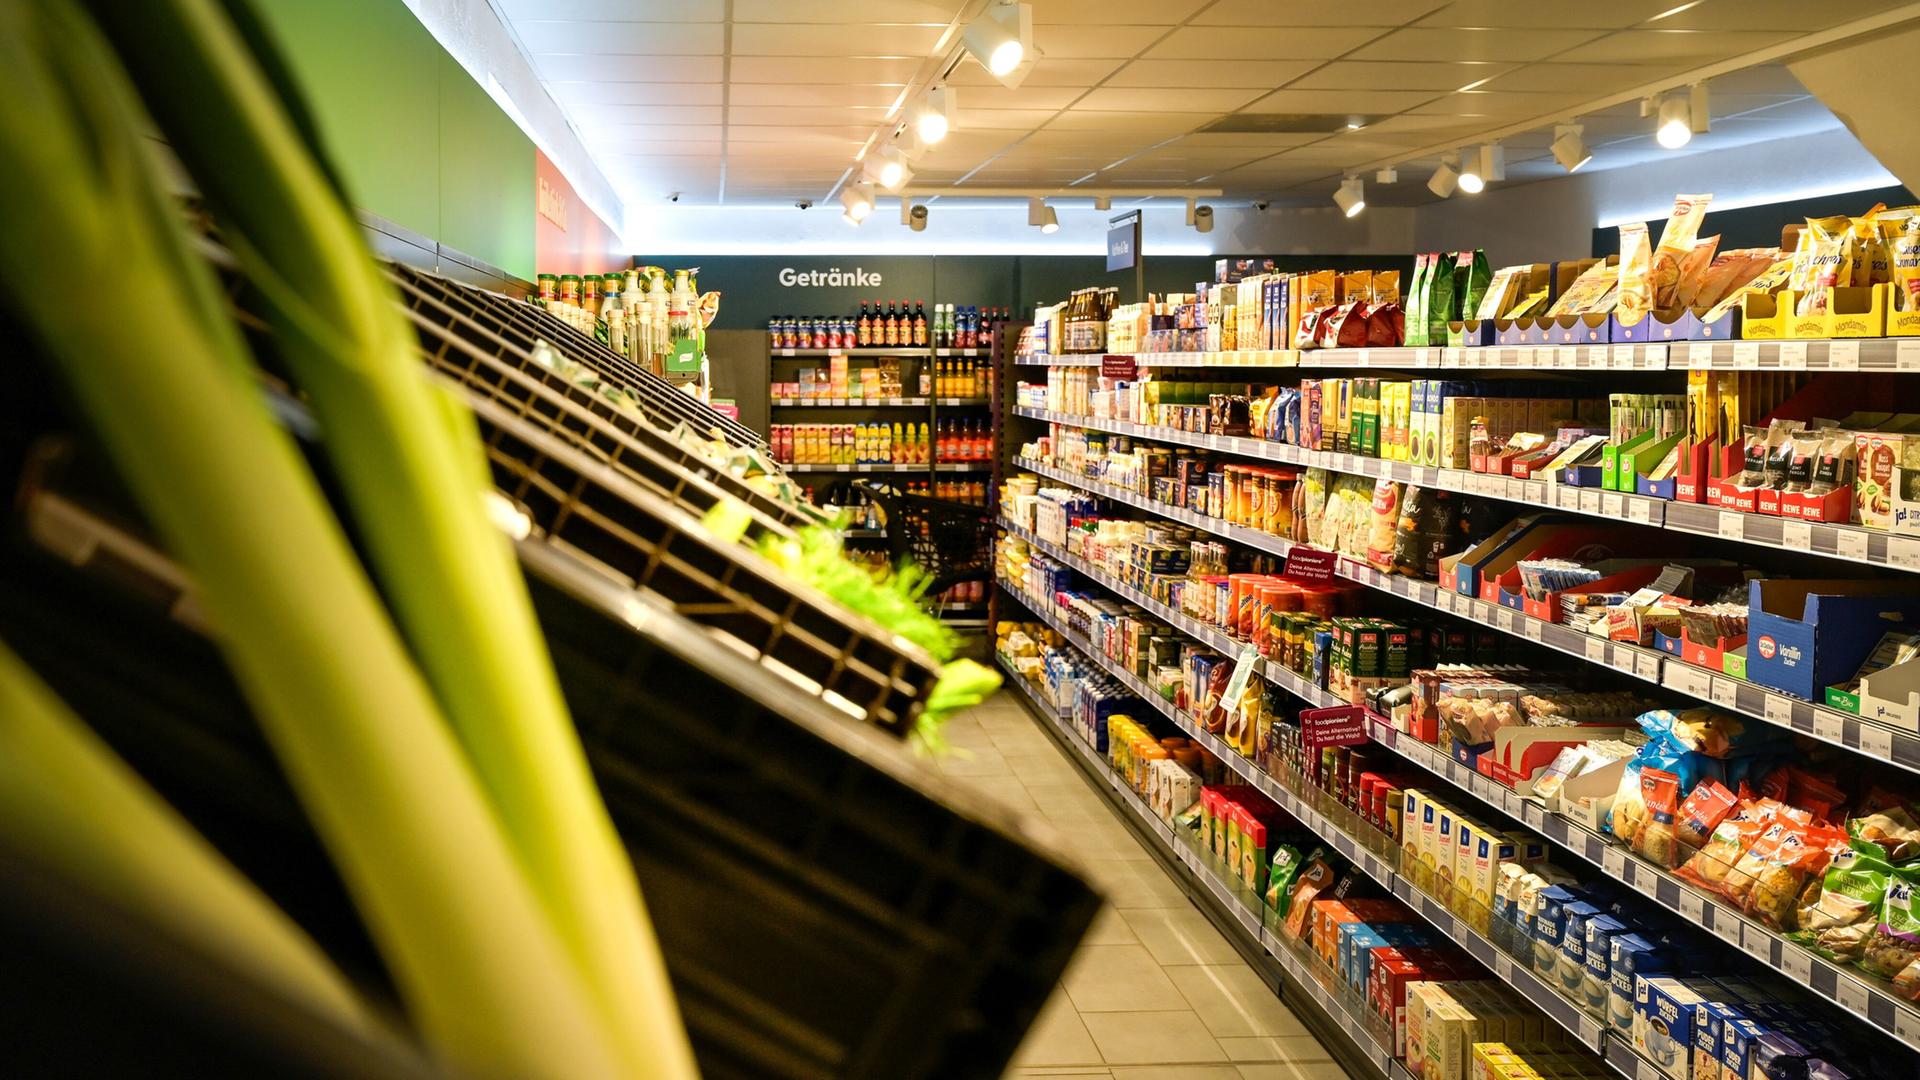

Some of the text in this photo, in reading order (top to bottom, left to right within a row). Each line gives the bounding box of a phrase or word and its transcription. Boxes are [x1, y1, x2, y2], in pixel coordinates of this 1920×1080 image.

[778, 267, 883, 287] Getränke
[1747, 322, 1776, 337] Mondamin
[1795, 320, 1824, 336] Mondamin
[1835, 319, 1868, 334] Mondamin
[1512, 463, 1528, 474] REWE
[1677, 484, 1695, 496] REWE
[1707, 487, 1721, 498] REW
[1736, 498, 1753, 509] REWE
[1760, 501, 1778, 512] REWE
[1782, 503, 1800, 515] REWE
[1803, 506, 1821, 518] REWE
[1895, 507, 1907, 526] ja!
[1779, 643, 1801, 661] Vanillin
[1841, 696, 1854, 708] Bio
[1331, 726, 1361, 734] Alternative?
[1637, 981, 1647, 999] ja!
[1656, 995, 1679, 1020] WÜRFEL
[1697, 1007, 1707, 1021] ja!
[1658, 1008, 1675, 1024] ZUCKER
[1697, 1028, 1715, 1047] PUDER
[1726, 1025, 1734, 1039] ja!
[1725, 1046, 1742, 1064] PUDER
